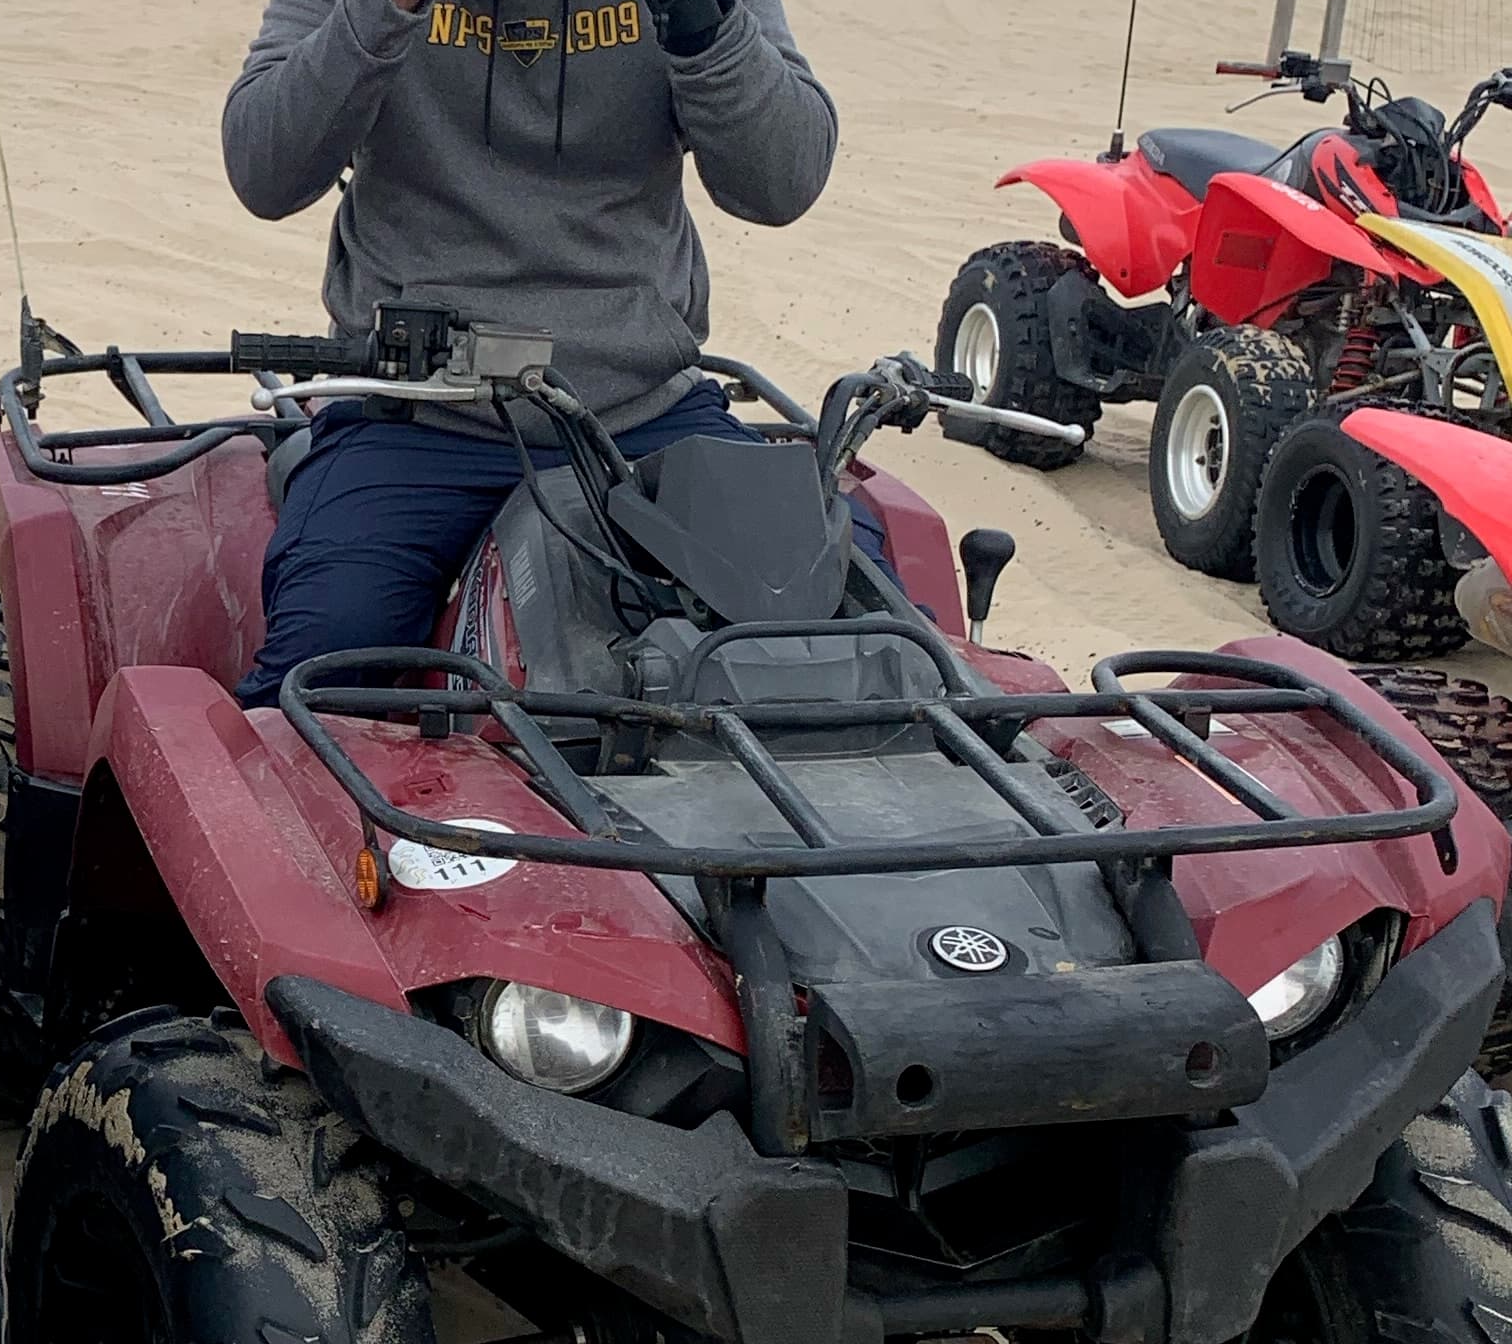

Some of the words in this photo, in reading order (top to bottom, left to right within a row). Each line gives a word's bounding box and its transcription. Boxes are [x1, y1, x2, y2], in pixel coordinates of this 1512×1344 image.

[426, 2, 492, 55] NPS
[564, 0, 640, 55] 1909
[434, 859, 486, 881] 111
